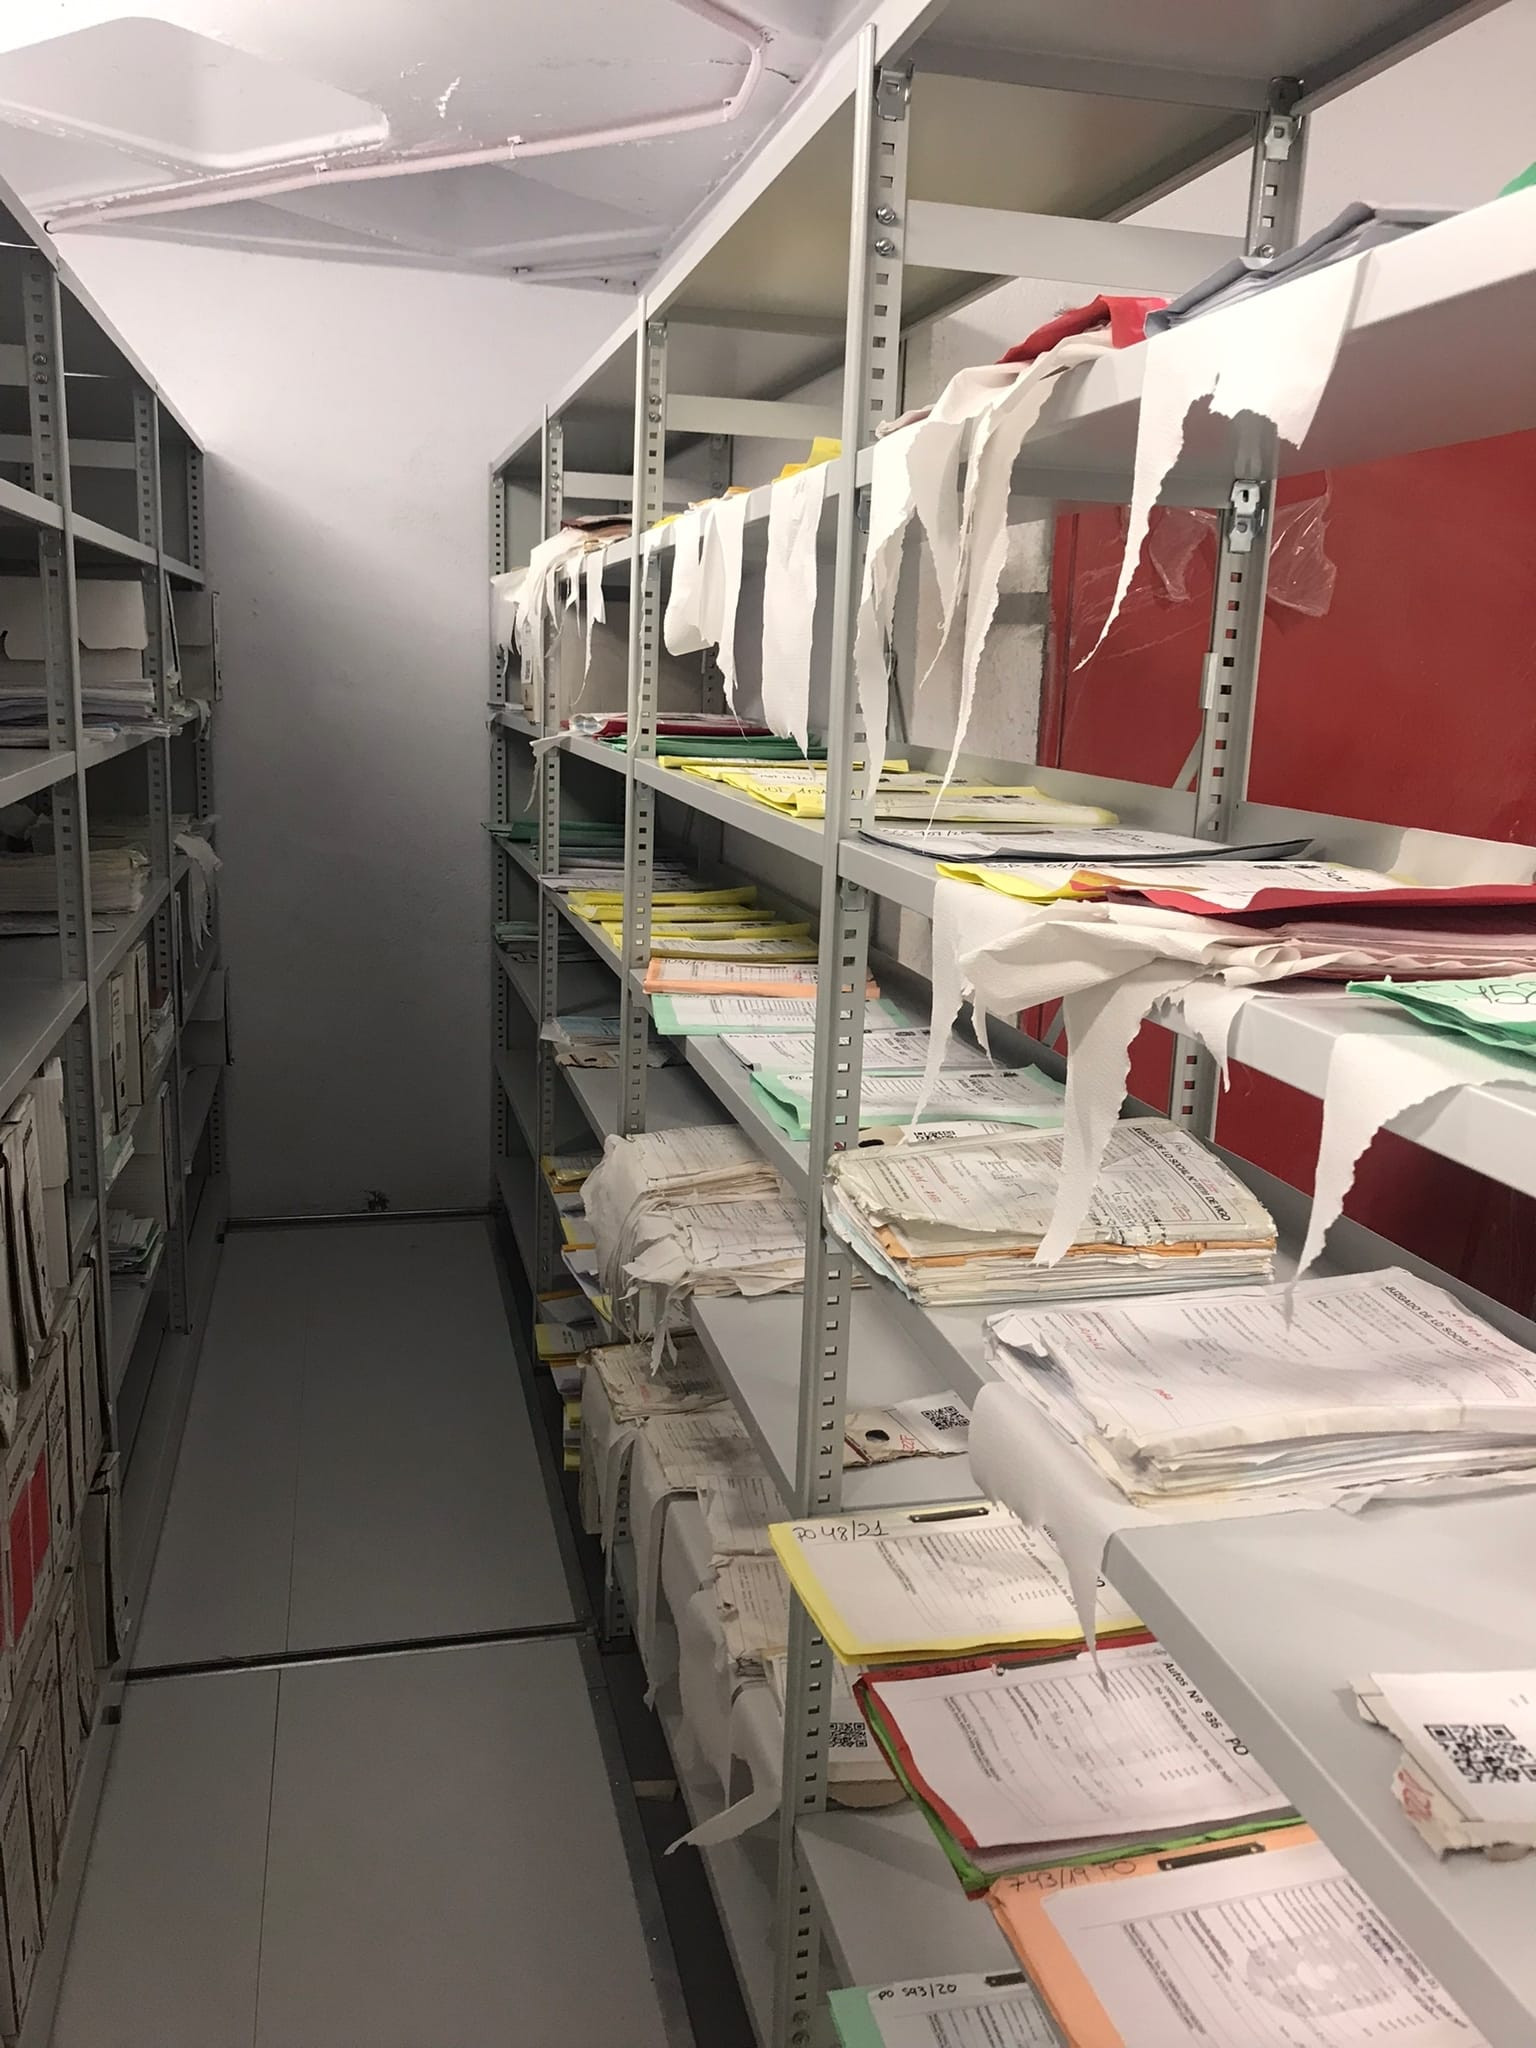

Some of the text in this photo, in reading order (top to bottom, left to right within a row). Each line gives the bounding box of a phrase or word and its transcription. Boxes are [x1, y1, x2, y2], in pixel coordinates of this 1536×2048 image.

[1168, 1157, 1190, 1176] SOCIAL
[1205, 1194, 1219, 1206] DE
[1214, 1203, 1231, 1221] VIGO
[1385, 1285, 1421, 1311] JUZGADO
[1418, 1309, 1433, 1319] DE
[1429, 1317, 1445, 1329] LO
[1442, 1325, 1471, 1348] SOCIAL
[792, 1519, 889, 1542] PO 48/21
[1163, 1661, 1188, 1687] Autos
[1201, 1710, 1223, 1729] 936
[1225, 1736, 1250, 1756] PO
[878, 1989, 895, 2001] PO
